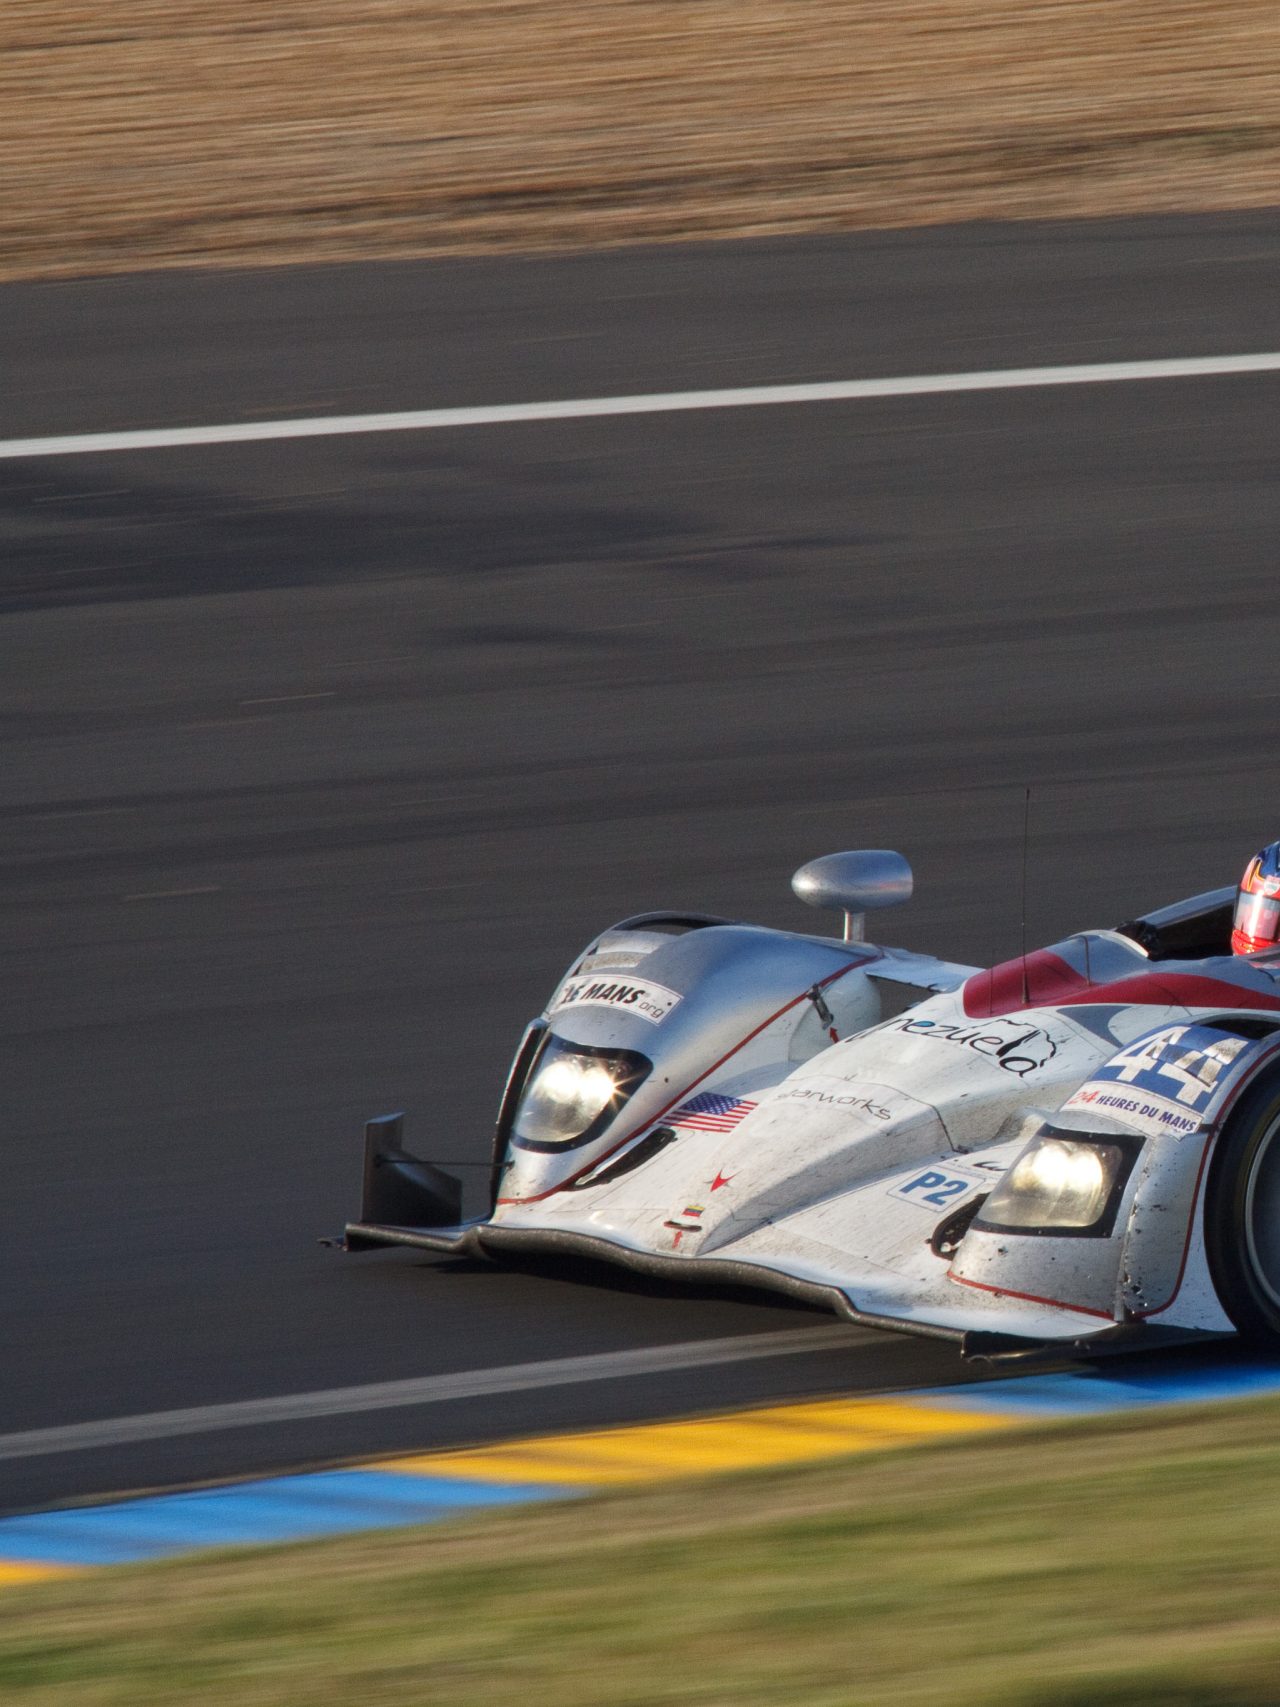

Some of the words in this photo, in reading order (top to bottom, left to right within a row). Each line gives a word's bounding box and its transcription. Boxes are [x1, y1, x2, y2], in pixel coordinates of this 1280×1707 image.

[581, 983, 645, 1004] MANS
[845, 1018, 1038, 1078] nezuela
[1104, 1026, 1248, 1105] 44
[1068, 1090, 1100, 1105] 24
[1097, 1095, 1138, 1112] HEURES
[1139, 1105, 1159, 1118] DU
[1159, 1111, 1197, 1132] MANS
[899, 1171, 968, 1206] P2
